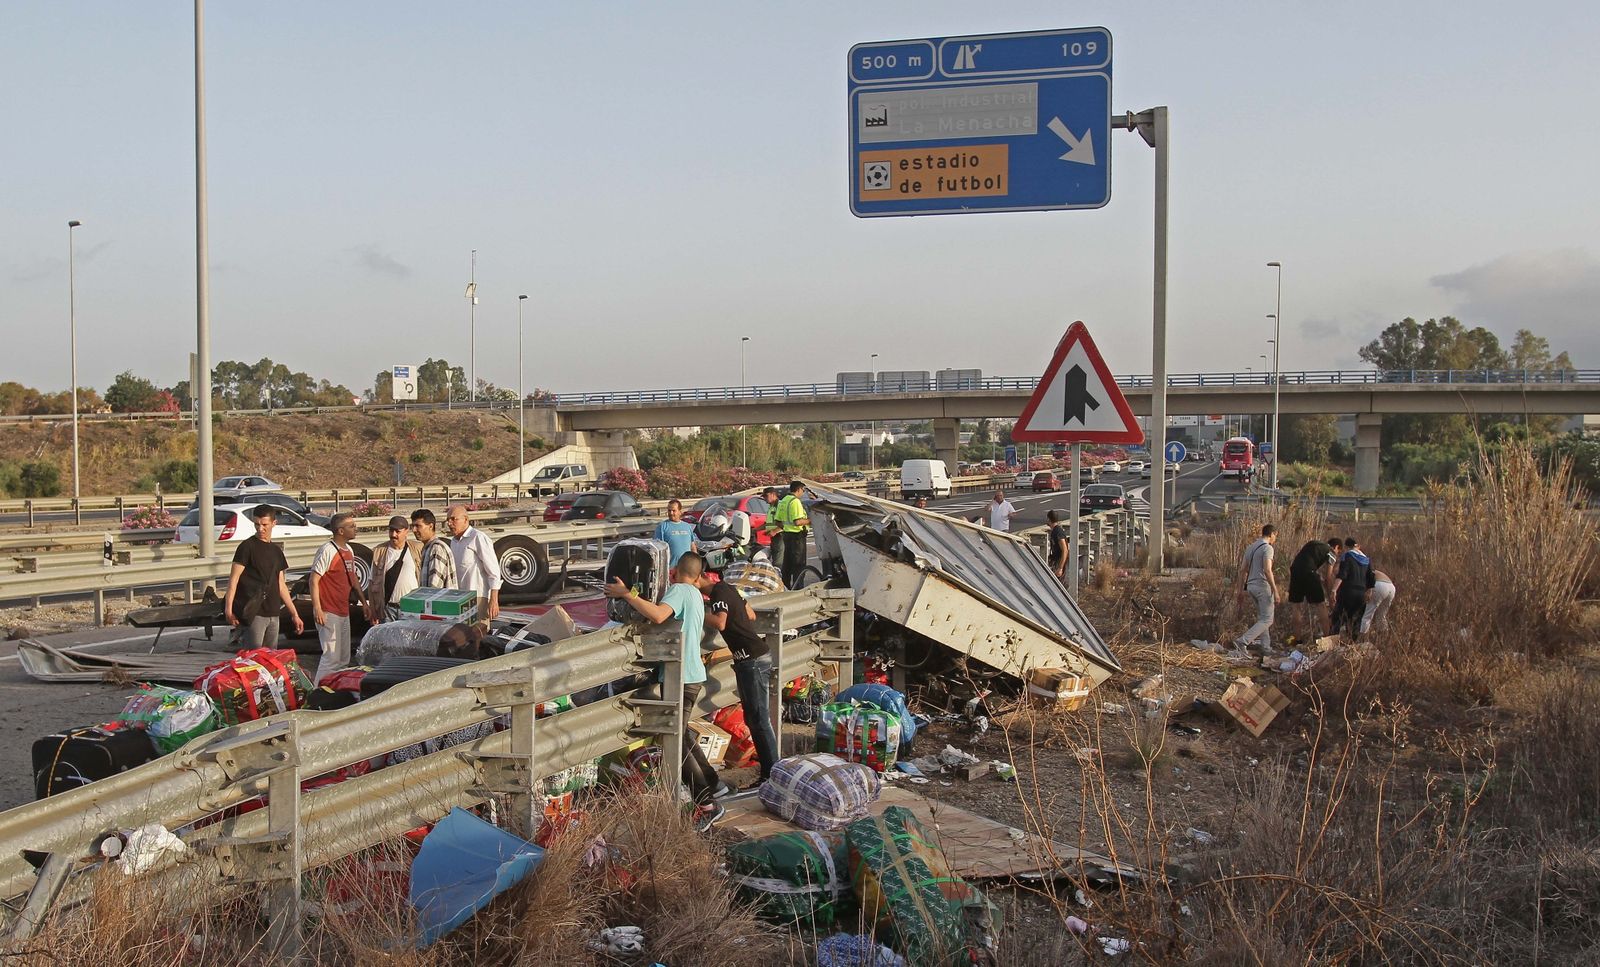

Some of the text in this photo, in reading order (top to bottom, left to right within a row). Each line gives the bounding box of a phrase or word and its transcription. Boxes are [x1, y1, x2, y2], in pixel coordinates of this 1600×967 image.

[1061, 42, 1097, 57] 109
[862, 55, 922, 70] 500 m
[900, 114, 1032, 134] La Menacha
[899, 153, 979, 171] estadio
[899, 174, 1001, 193] de futbol
